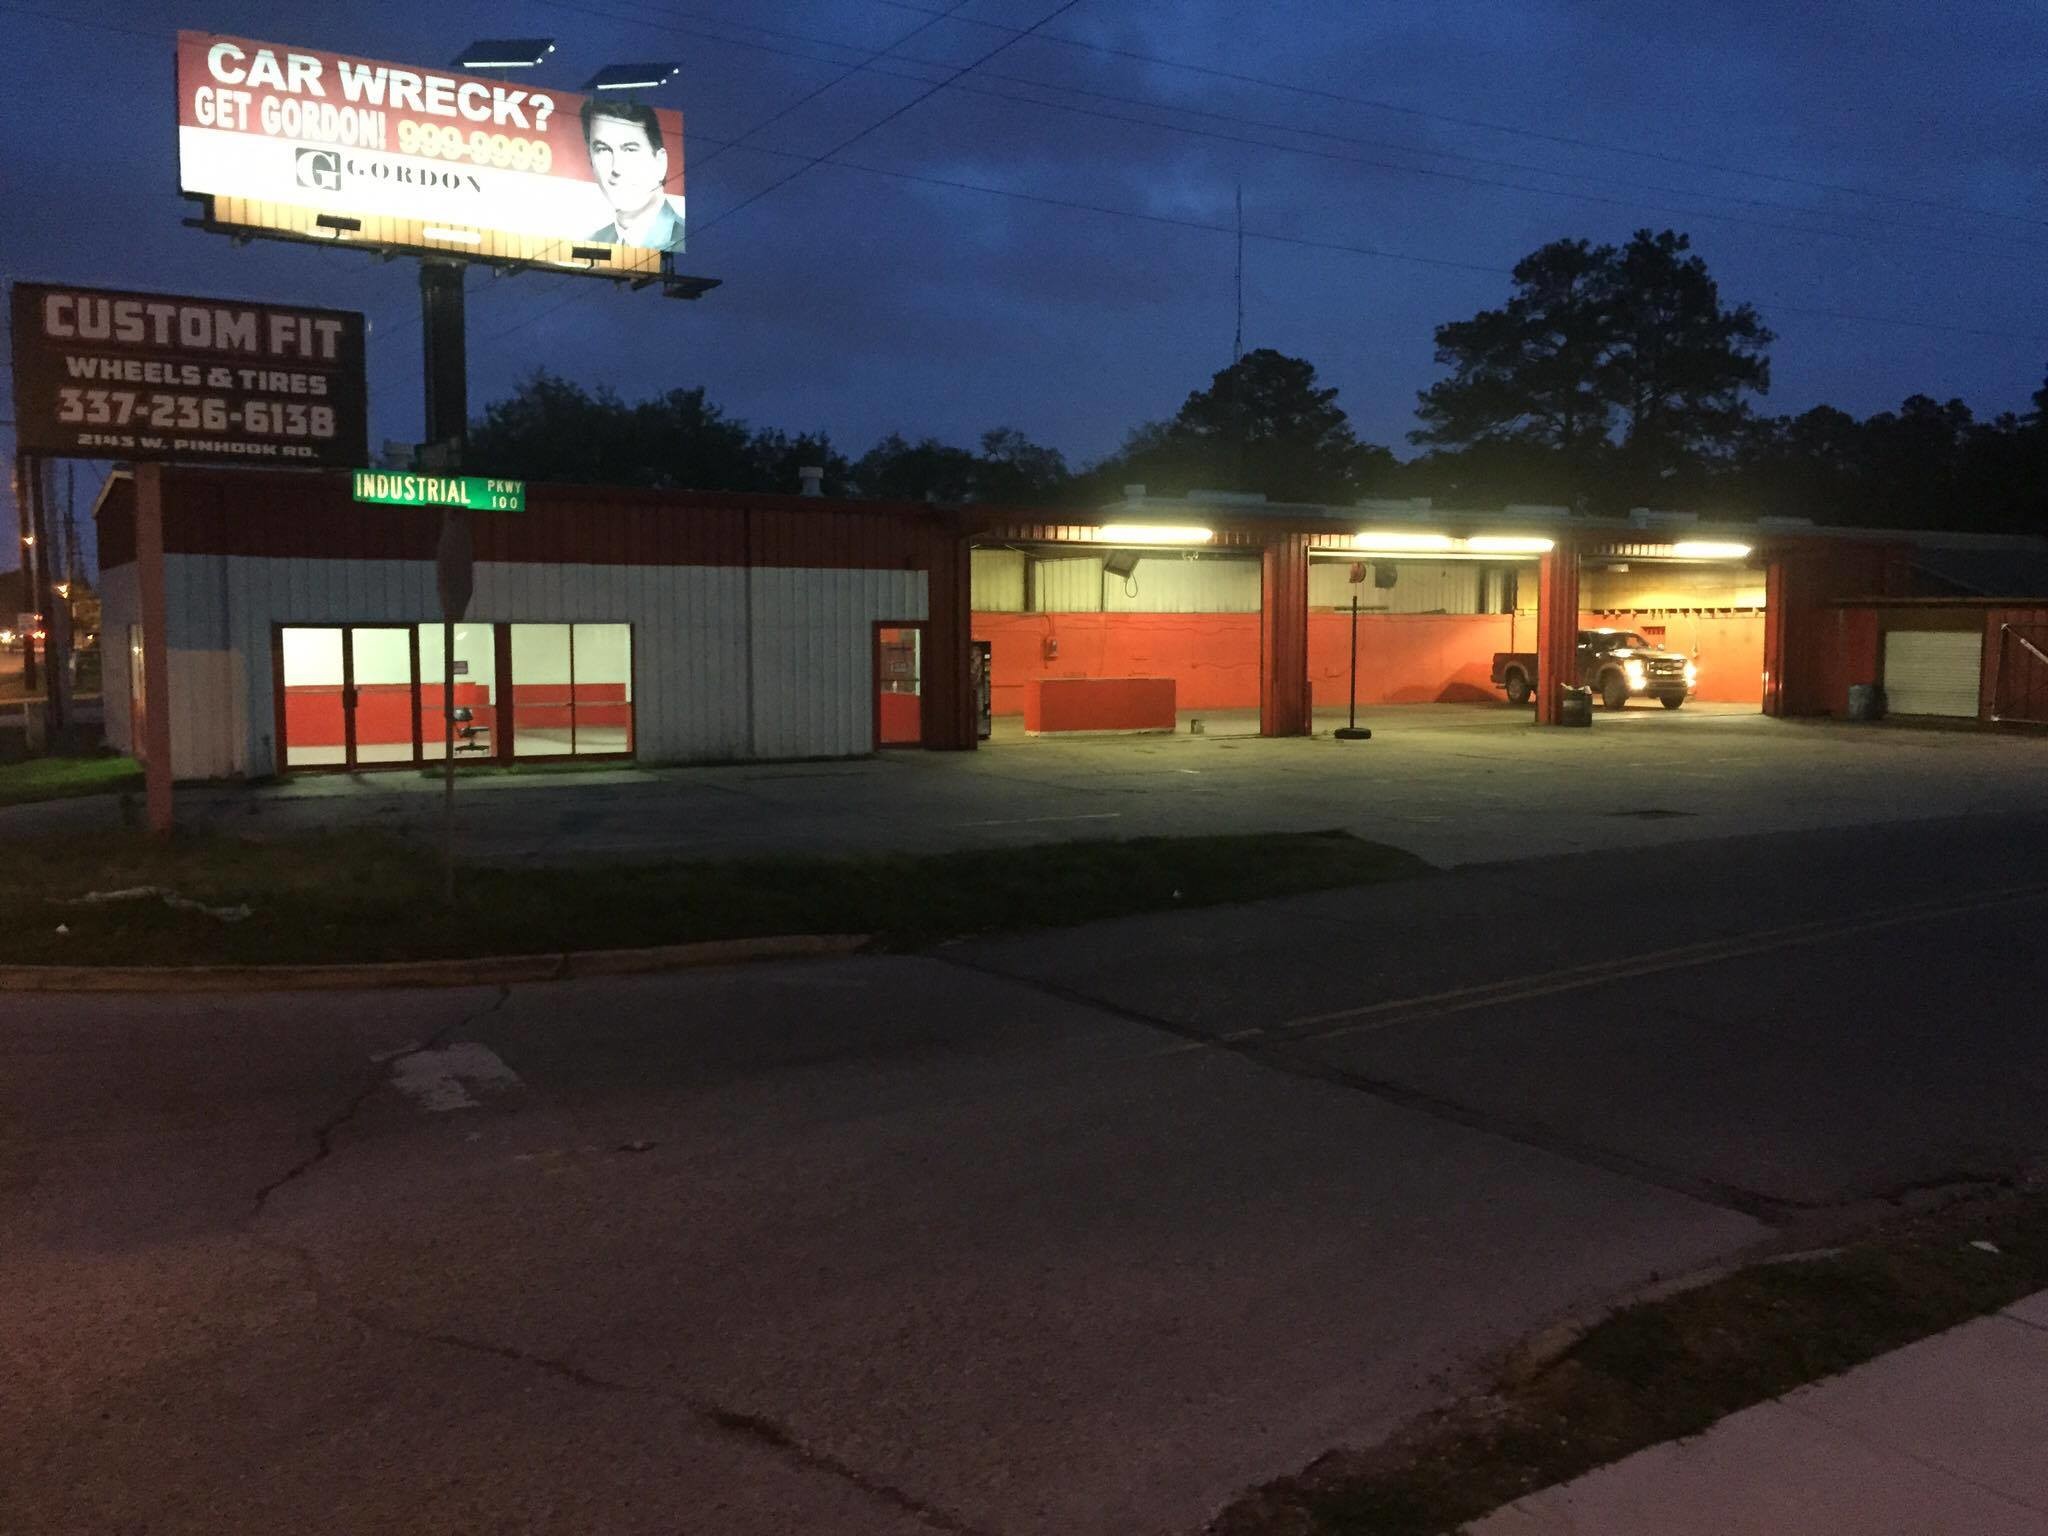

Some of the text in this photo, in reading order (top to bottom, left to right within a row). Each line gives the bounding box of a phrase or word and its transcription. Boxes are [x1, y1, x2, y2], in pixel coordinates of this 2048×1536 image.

[207, 42, 555, 131] CAR WRECK?
[195, 85, 552, 174] GET GORDON! 999-9999
[347, 160, 482, 193] GORDON
[45, 294, 343, 359] CUSTOM FIT
[66, 356, 327, 397] WHEELS & TIRES
[58, 389, 336, 438] 337-236-6138
[141, 437, 168, 450] W.
[174, 439, 278, 456] PINHOOK
[282, 445, 319, 458] RD.
[355, 473, 522, 505] INDUSTRIAL PKWY
[492, 496, 518, 509] 100
